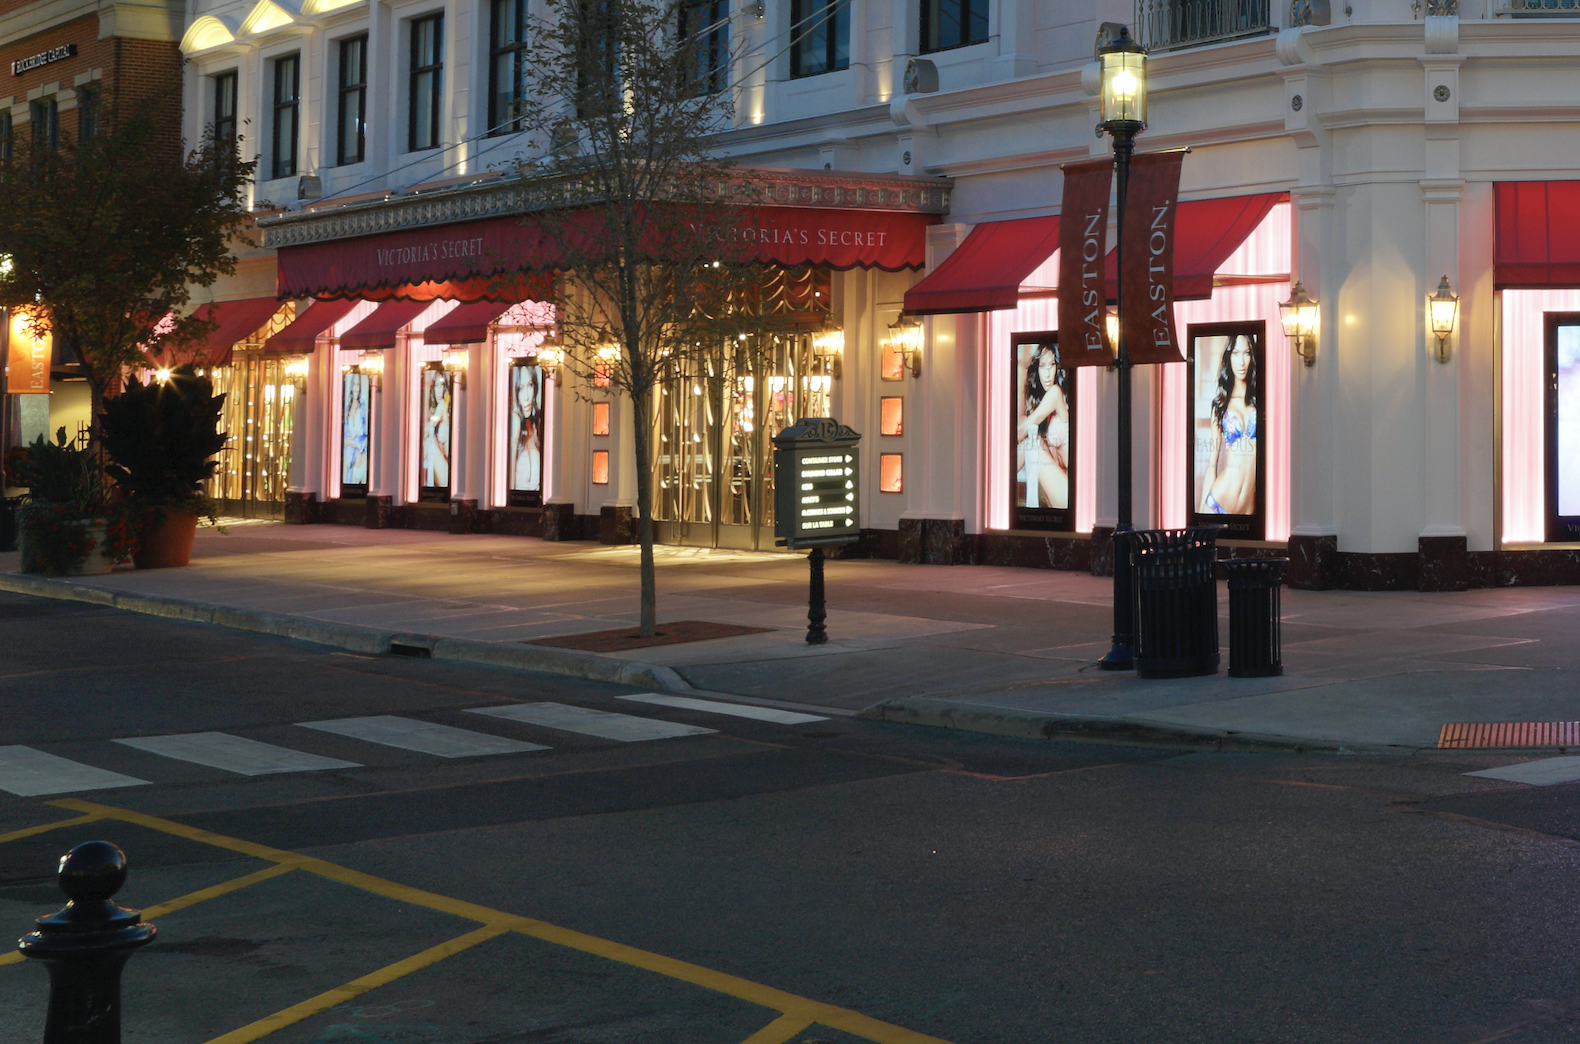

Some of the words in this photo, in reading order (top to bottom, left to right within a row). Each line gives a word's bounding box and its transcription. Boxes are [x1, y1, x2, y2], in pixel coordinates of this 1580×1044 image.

[690, 223, 809, 245] CTORIA'S
[817, 228, 887, 247] SECRET
[377, 243, 438, 266] VICTORIA'S
[442, 237, 483, 259] SECRET
[31, 339, 46, 389] EASTO
[1196, 437, 1254, 453] FABUOUS
